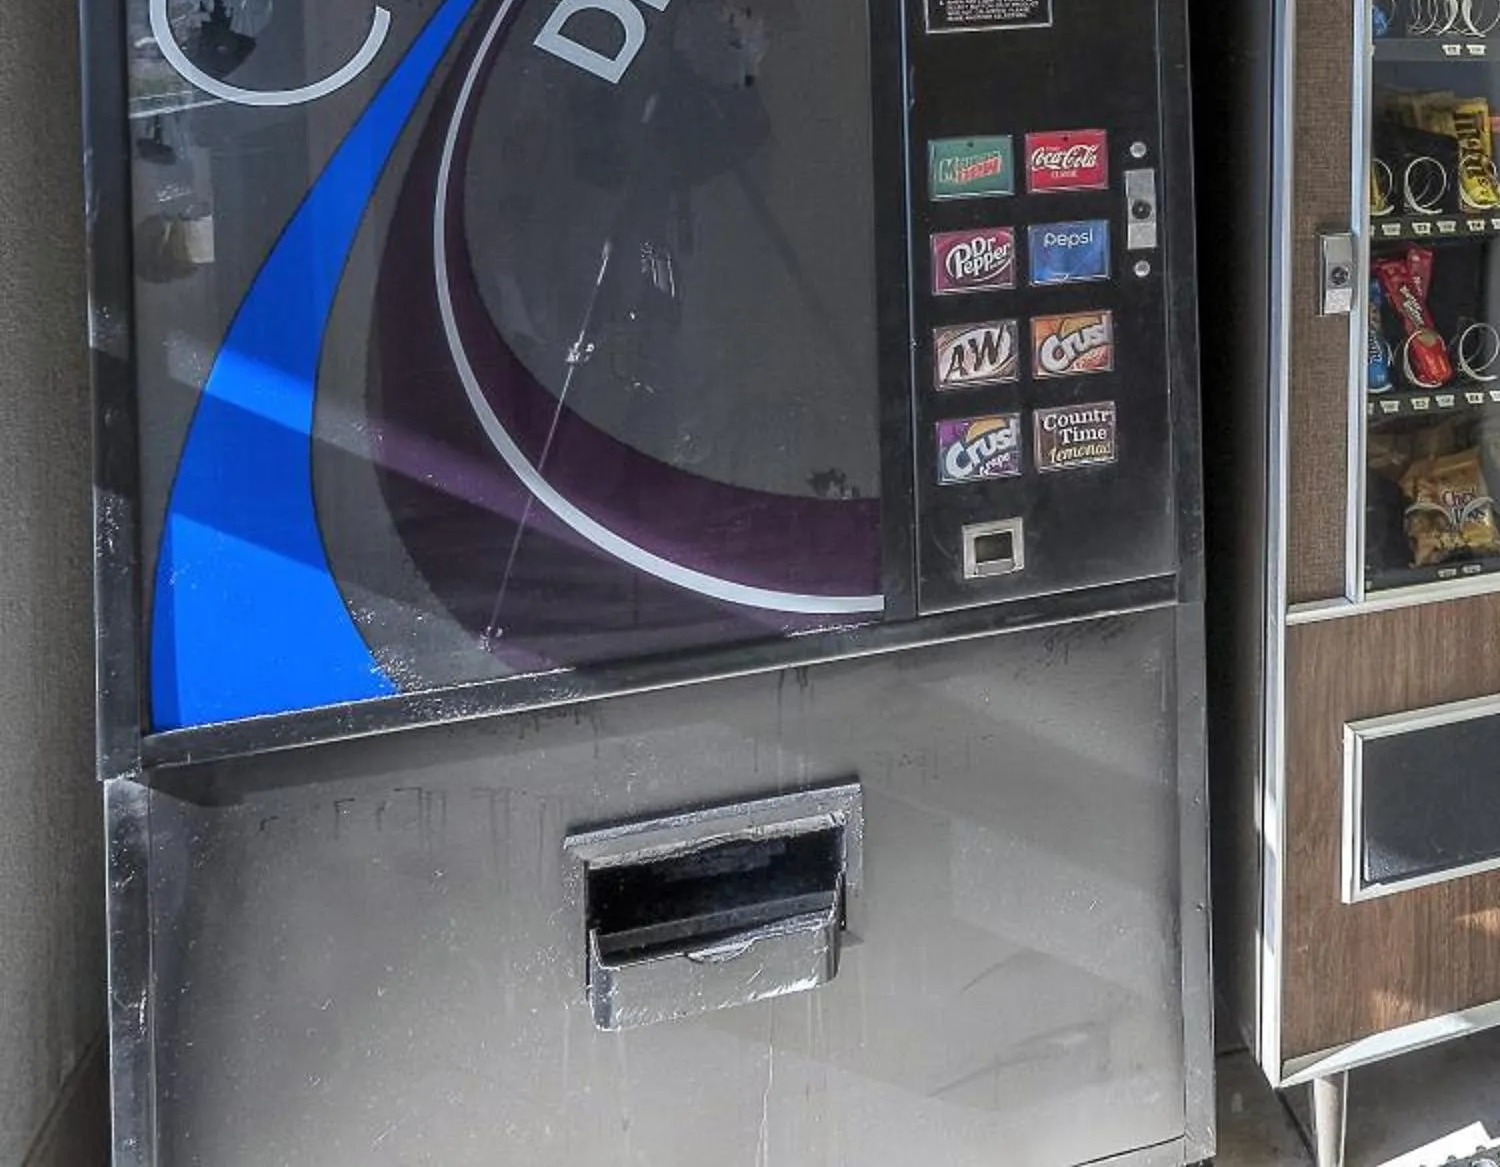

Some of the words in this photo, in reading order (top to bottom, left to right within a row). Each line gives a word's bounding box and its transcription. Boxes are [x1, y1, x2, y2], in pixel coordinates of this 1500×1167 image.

[971, 236, 996, 257] Dr
[1043, 227, 1093, 249] pepsi
[945, 242, 1011, 280] Pepper
[1043, 410, 1111, 431] Countr
[1060, 427, 1107, 445] Time
